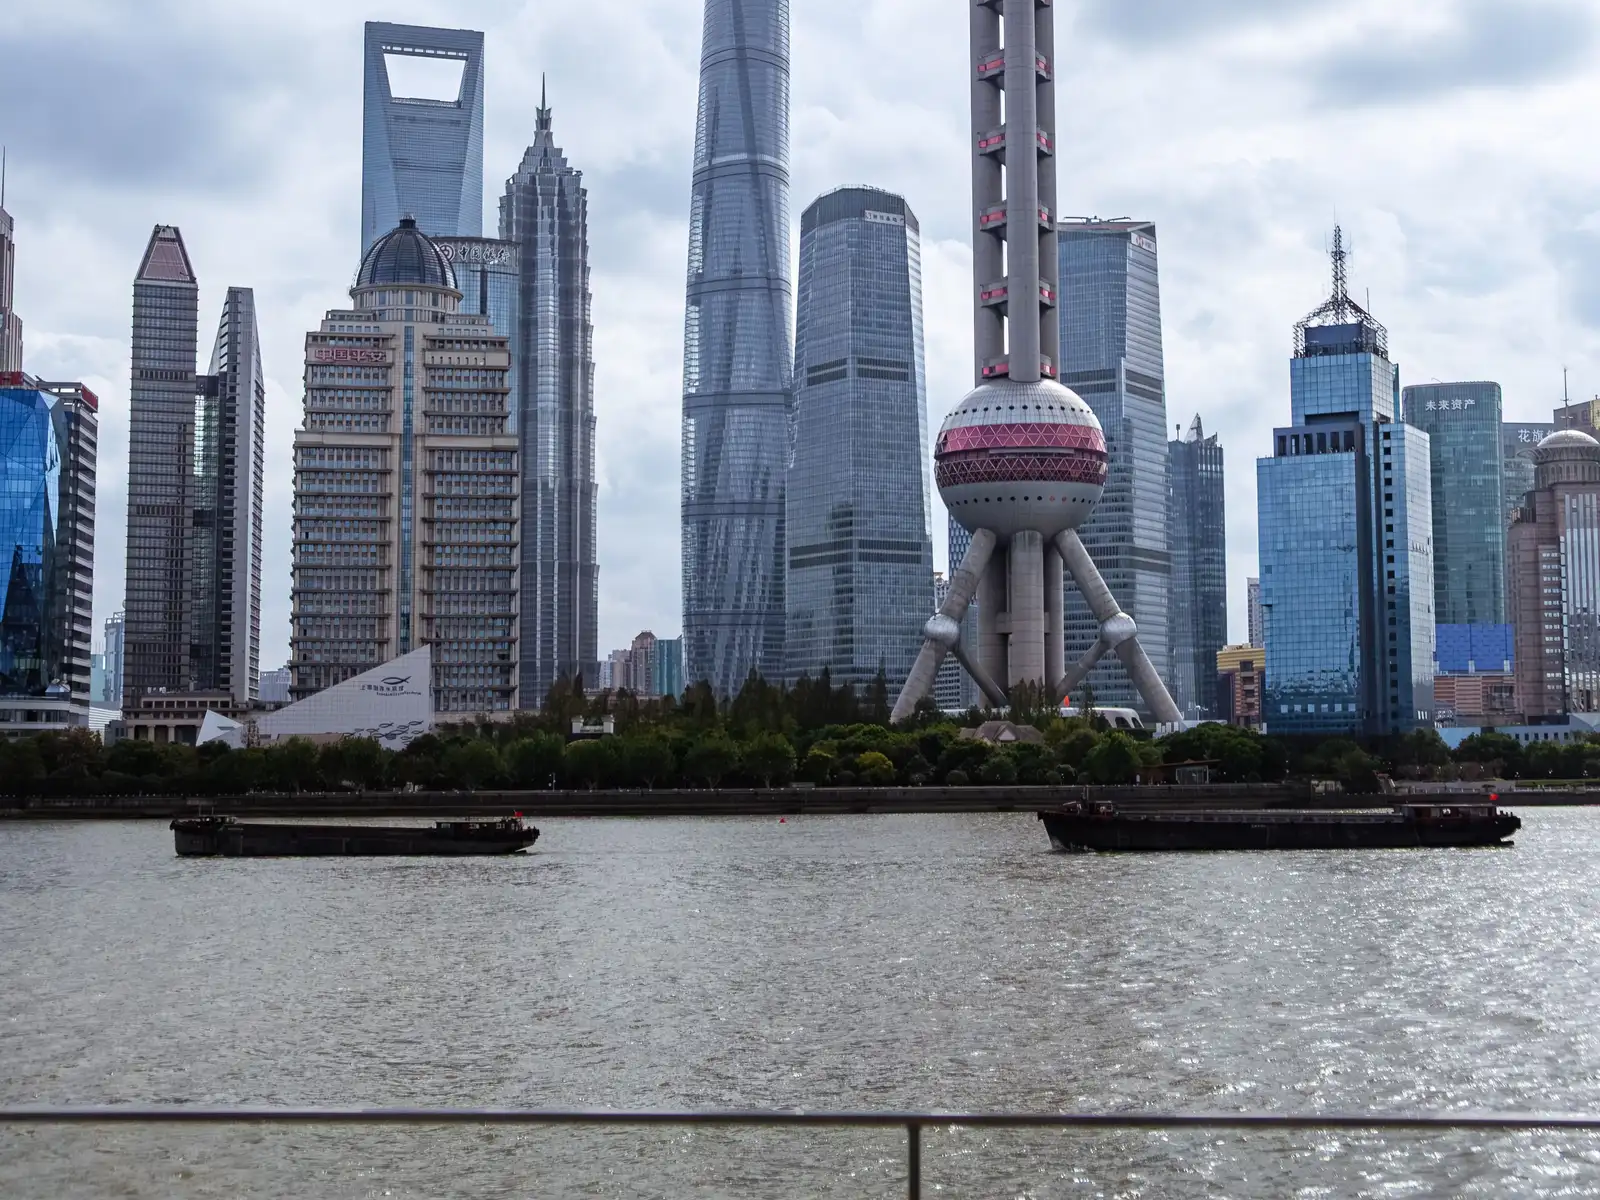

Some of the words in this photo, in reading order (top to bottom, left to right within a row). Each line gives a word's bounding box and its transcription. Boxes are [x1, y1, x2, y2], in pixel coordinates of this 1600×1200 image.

[458, 245, 510, 263] 中国银行
[315, 348, 386, 362] 中国平安
[1425, 398, 1475, 411] 未来资产
